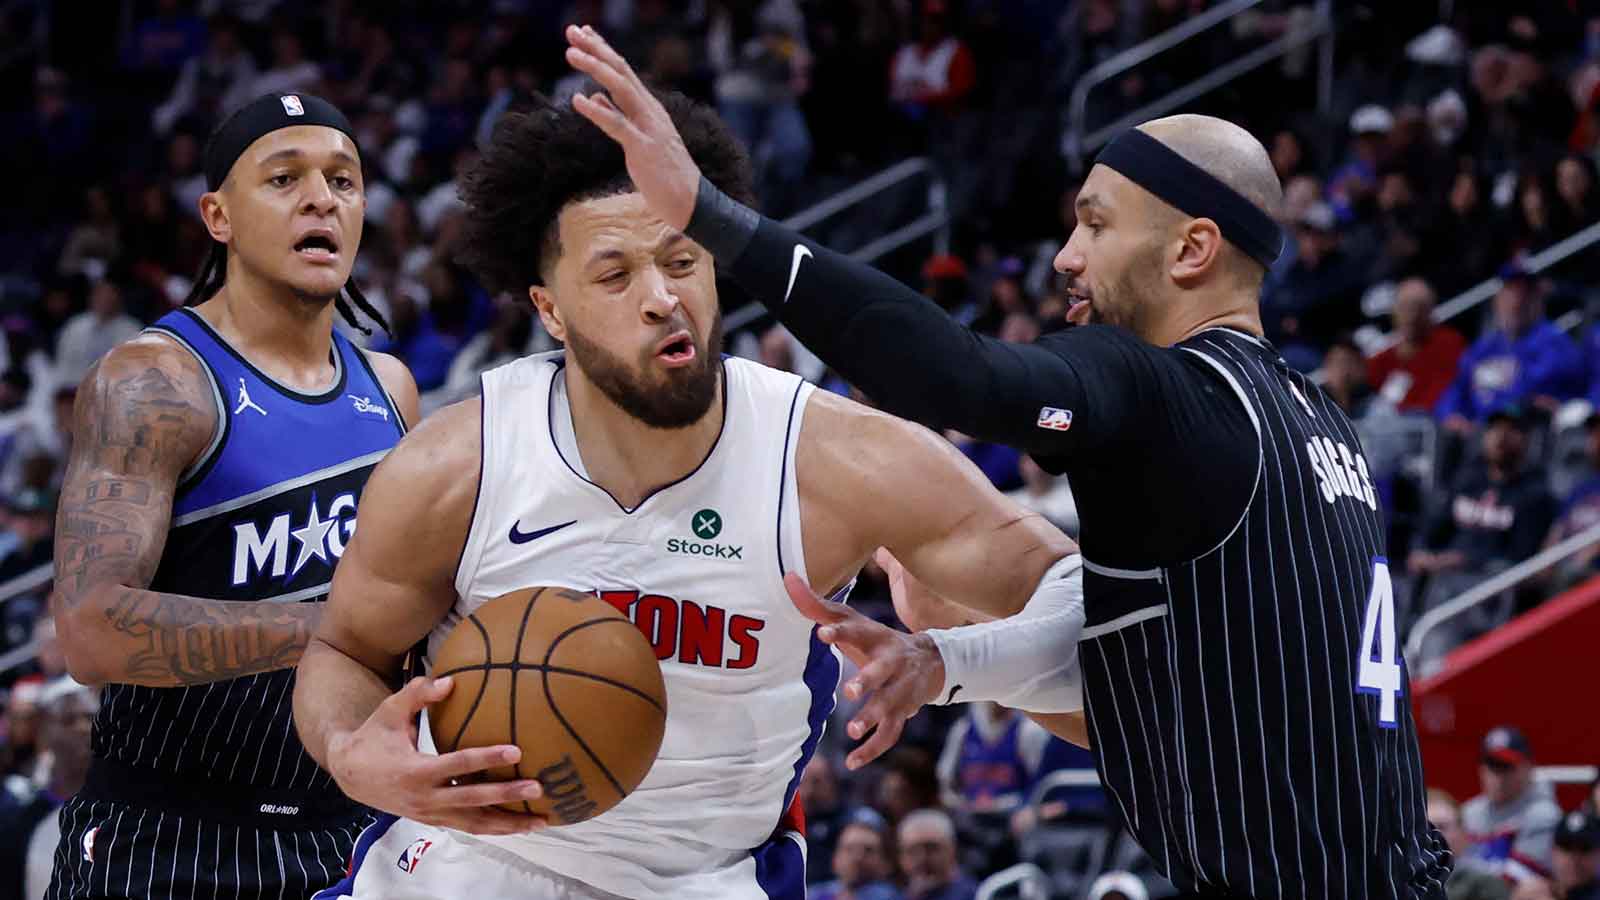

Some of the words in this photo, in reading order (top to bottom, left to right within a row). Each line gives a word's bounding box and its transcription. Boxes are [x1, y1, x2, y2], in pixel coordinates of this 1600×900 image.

[347, 394, 389, 422] Disney
[1306, 435, 1377, 512] SUGGS
[666, 538, 743, 560] StockX
[1356, 556, 1404, 728] 4
